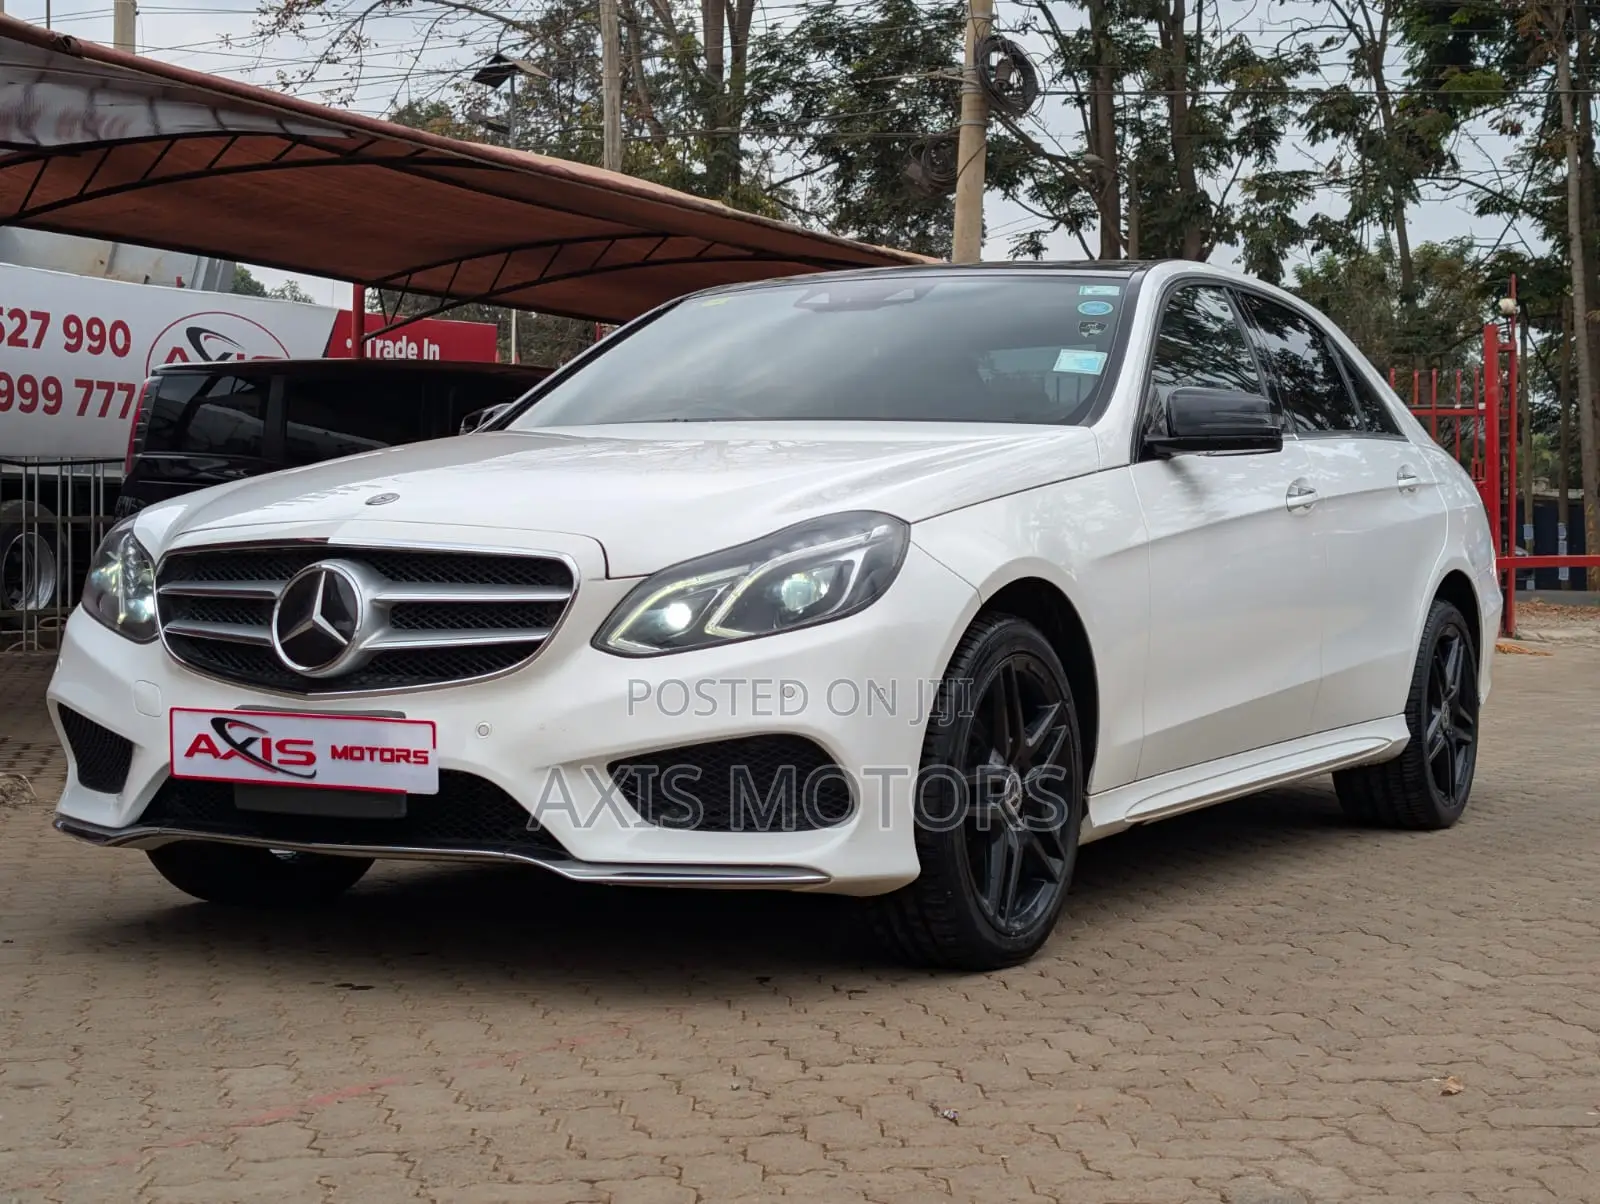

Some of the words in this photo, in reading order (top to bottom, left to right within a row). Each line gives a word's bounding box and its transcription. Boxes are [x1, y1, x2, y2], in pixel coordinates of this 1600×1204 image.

[0, 306, 51, 349] 27
[62, 313, 132, 358] 990
[364, 333, 418, 360] Trade
[423, 338, 440, 360] In
[74, 378, 136, 419] 777
[184, 717, 317, 779] AXIS
[330, 744, 429, 765] MOTORS
